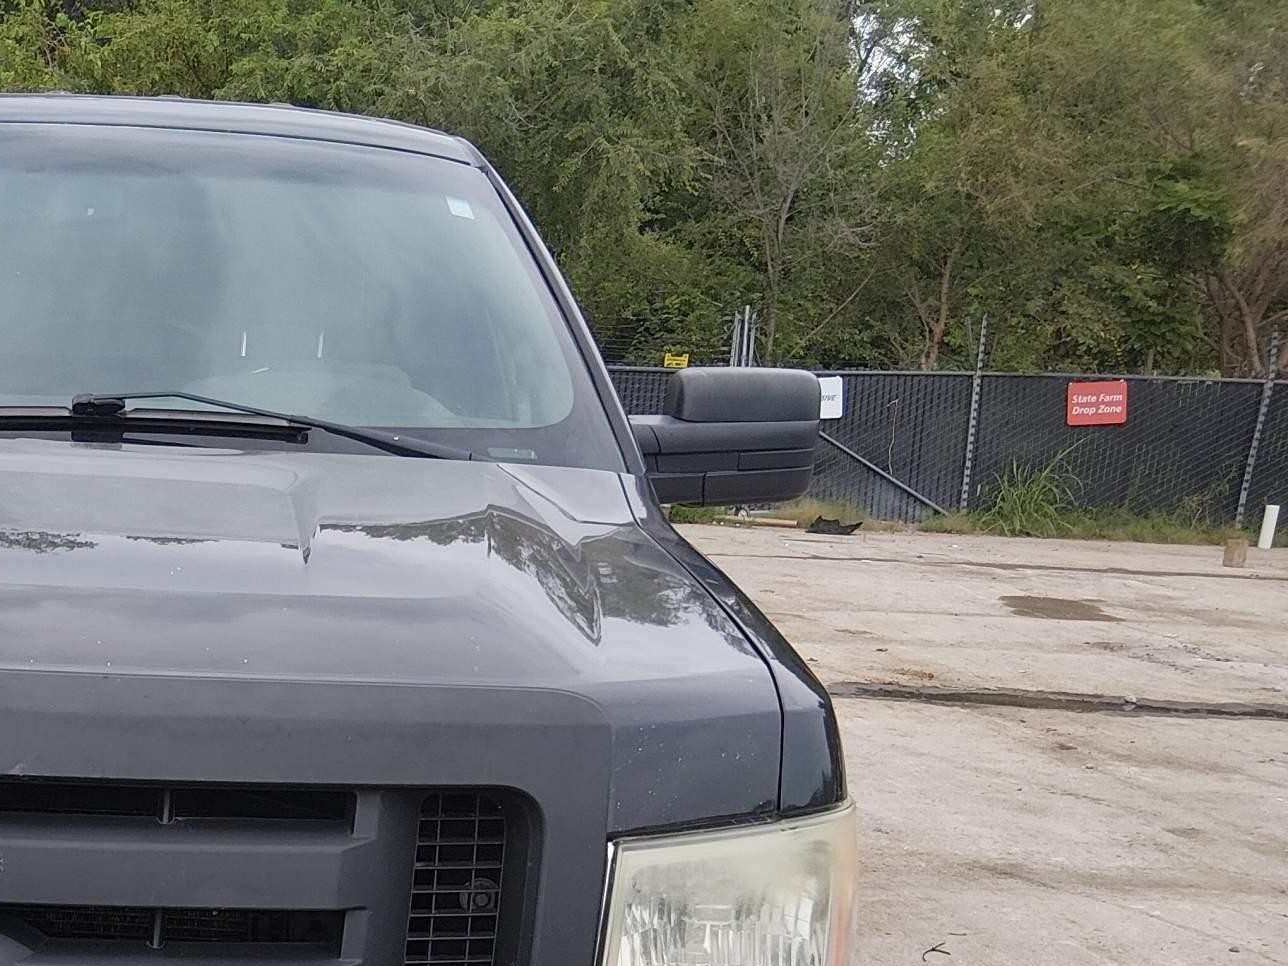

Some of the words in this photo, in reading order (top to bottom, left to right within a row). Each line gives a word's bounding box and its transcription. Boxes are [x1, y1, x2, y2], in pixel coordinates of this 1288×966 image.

[1072, 394, 1097, 403] State
[1099, 393, 1123, 402] Farm
[1072, 406, 1096, 416] Drop
[1097, 405, 1122, 414] Zone
